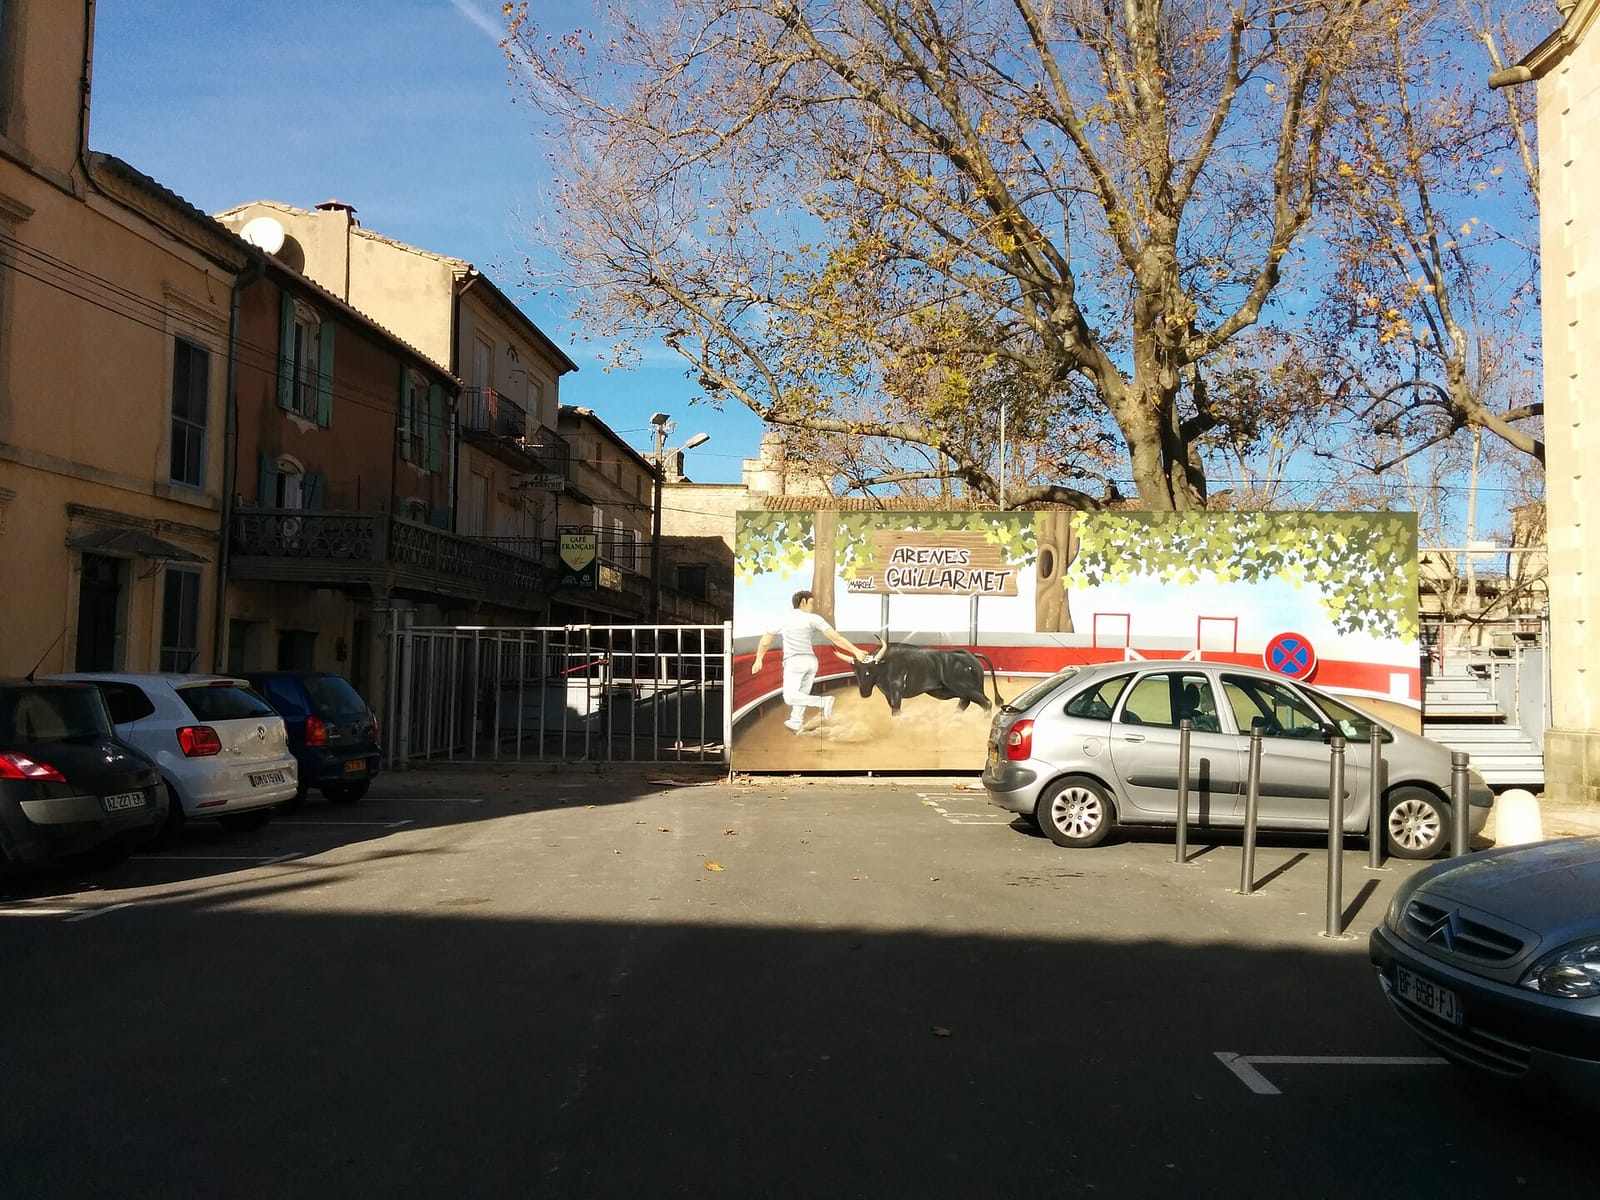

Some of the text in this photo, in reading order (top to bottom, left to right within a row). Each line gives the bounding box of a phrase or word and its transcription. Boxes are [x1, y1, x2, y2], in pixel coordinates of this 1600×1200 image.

[570, 535, 587, 543] CAFÉ
[561, 543, 595, 551] FRANÇAIS
[891, 548, 969, 564] ARENES
[887, 567, 1010, 591] GUILLARMET
